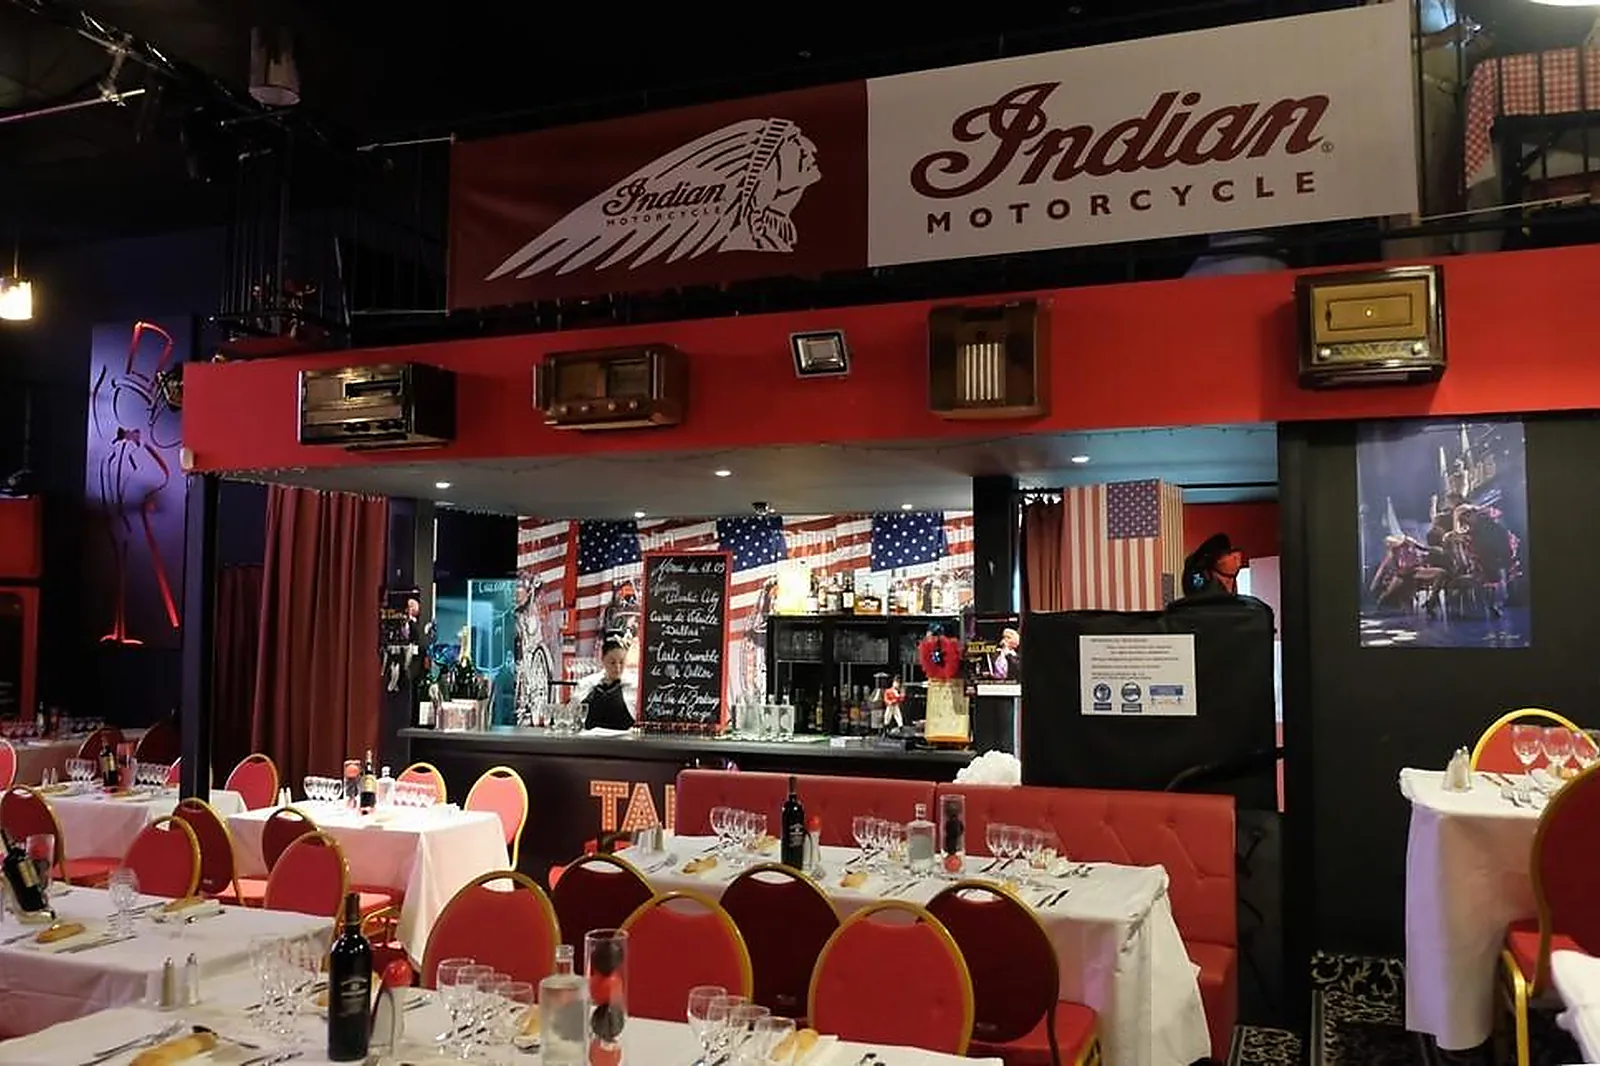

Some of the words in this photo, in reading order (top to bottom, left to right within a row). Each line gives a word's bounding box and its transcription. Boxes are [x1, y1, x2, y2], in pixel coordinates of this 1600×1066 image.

[910, 81, 1331, 199] Indian
[602, 178, 723, 217] Indian
[606, 206, 722, 227] MOTORCYCLE
[927, 171, 1315, 233] MOTORCYCLE
